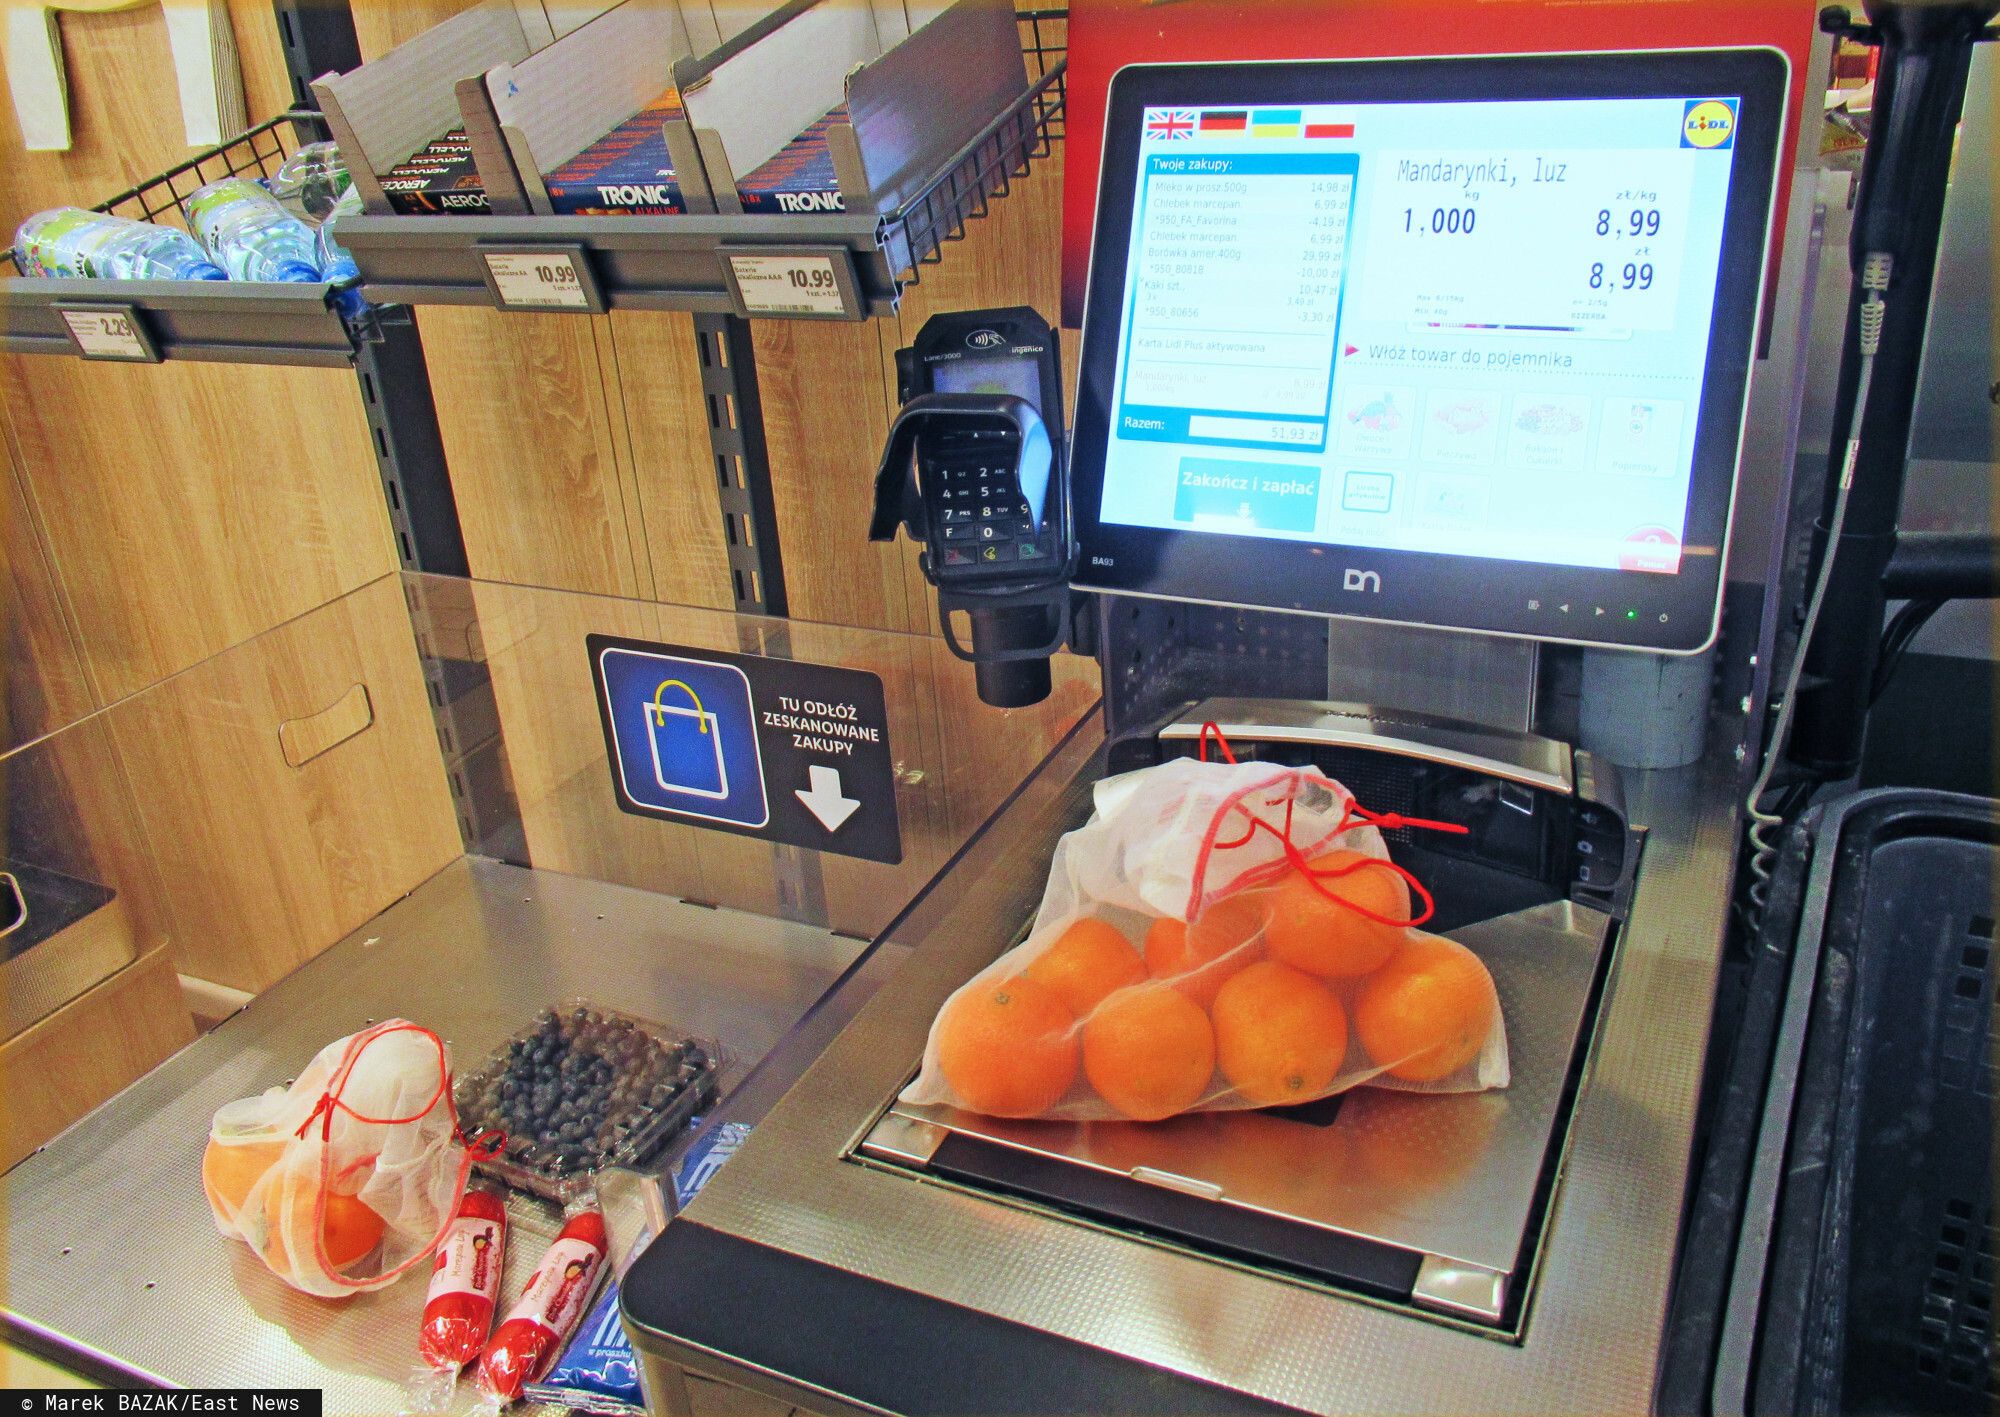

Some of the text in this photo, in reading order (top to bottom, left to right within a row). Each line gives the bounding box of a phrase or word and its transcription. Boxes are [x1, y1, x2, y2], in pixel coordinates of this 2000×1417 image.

[1153, 158, 1233, 172] Twoje zakupy:
[1398, 156, 1568, 188] Mandarynki, luz
[597, 185, 670, 205] TRONIC
[775, 192, 846, 212] TRONIC
[1464, 190, 1480, 201] kg
[1404, 208, 1477, 238] 1,000
[1596, 208, 1662, 240] 8,99
[535, 266, 576, 282] 10.99
[788, 269, 834, 288] 10.99
[1588, 262, 1655, 293] 8,99
[1011, 345, 1044, 354] ingenico
[1368, 344, 1573, 370] Włóż towar do pojemnika
[1124, 417, 1165, 430] Razem:
[942, 470, 948, 480] 1
[980, 468, 988, 478] 2
[981, 486, 989, 496] 5
[1182, 472, 1249, 490] Zakończ
[1262, 480, 1314, 496] zapłać
[942, 489, 952, 498] 4
[945, 510, 952, 520] 7
[982, 507, 992, 516] 8
[946, 528, 953, 538] F
[1092, 556, 1114, 567] BA93
[779, 696, 858, 721] TU ODŁÓŻ
[764, 712, 880, 742] ZESKANOWANE
[792, 734, 854, 756] ZAKUPY
